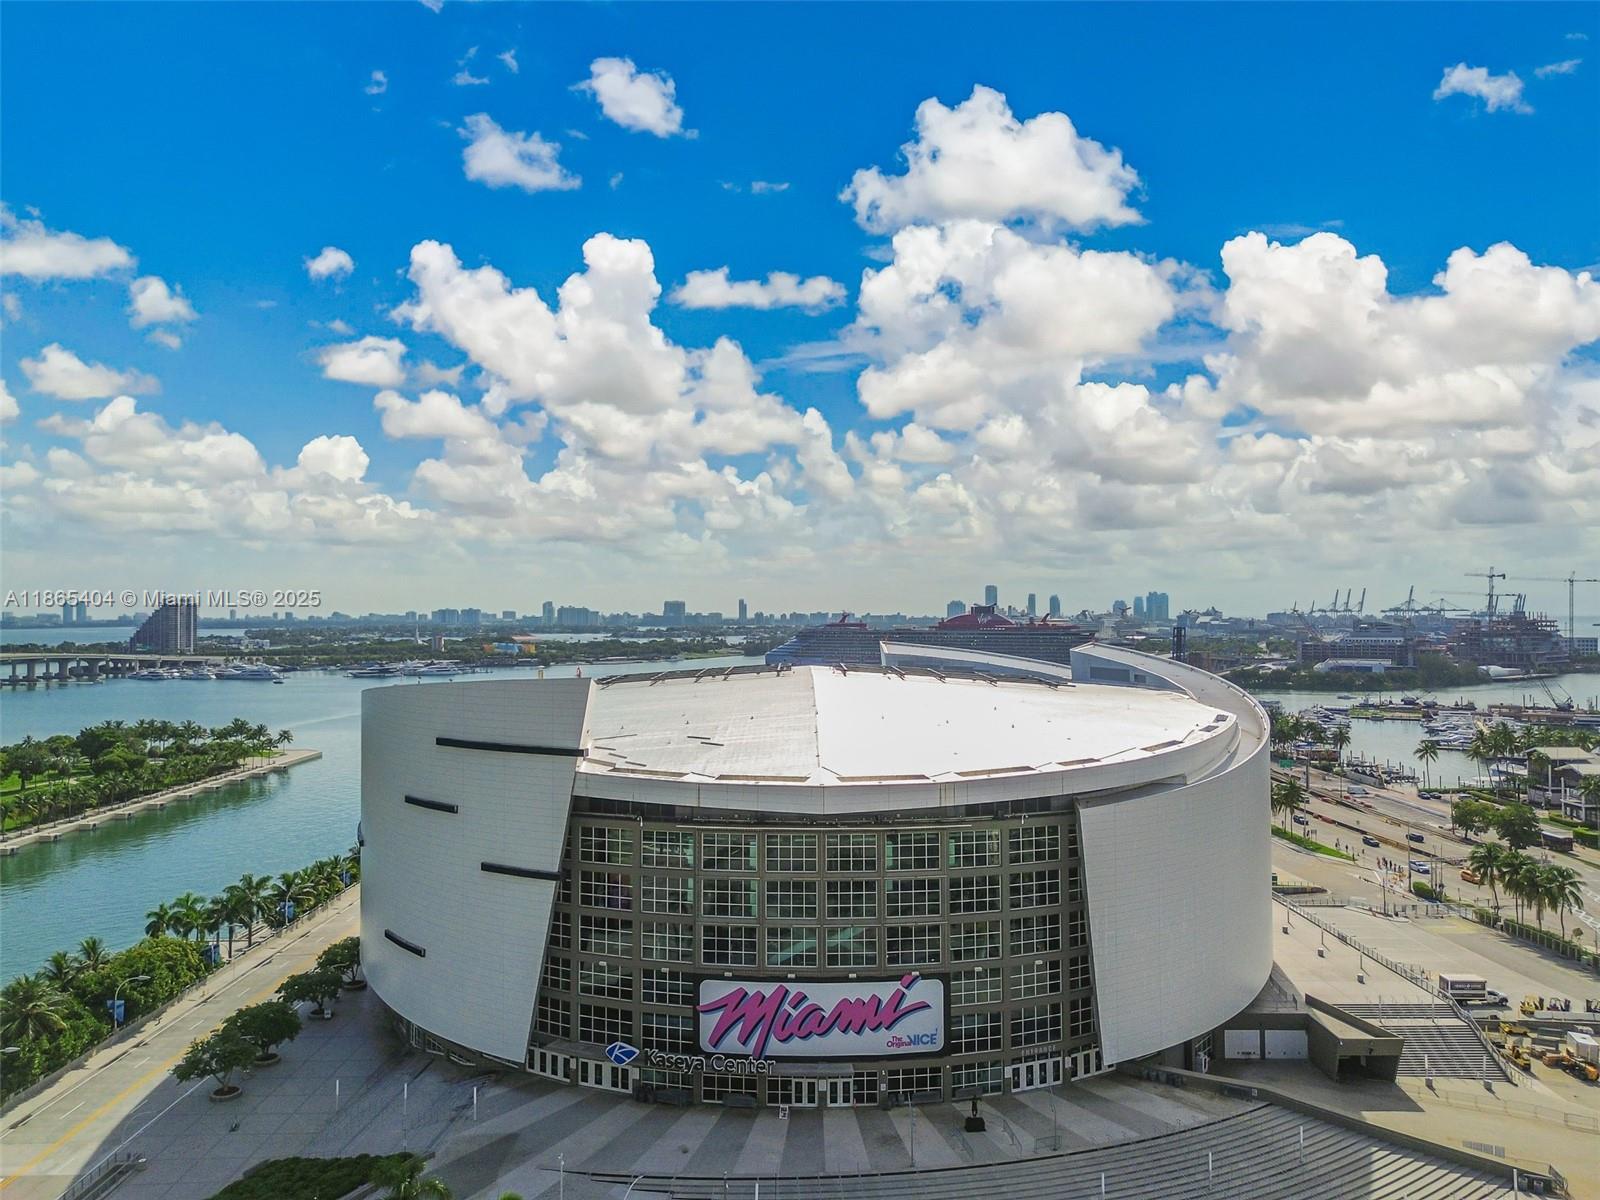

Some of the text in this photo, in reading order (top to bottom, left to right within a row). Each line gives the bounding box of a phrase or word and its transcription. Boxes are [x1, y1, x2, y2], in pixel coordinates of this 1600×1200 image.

[696, 975, 932, 1057] Miami
[644, 1048, 706, 1075] Kaseya
[711, 1053, 776, 1075] Center
